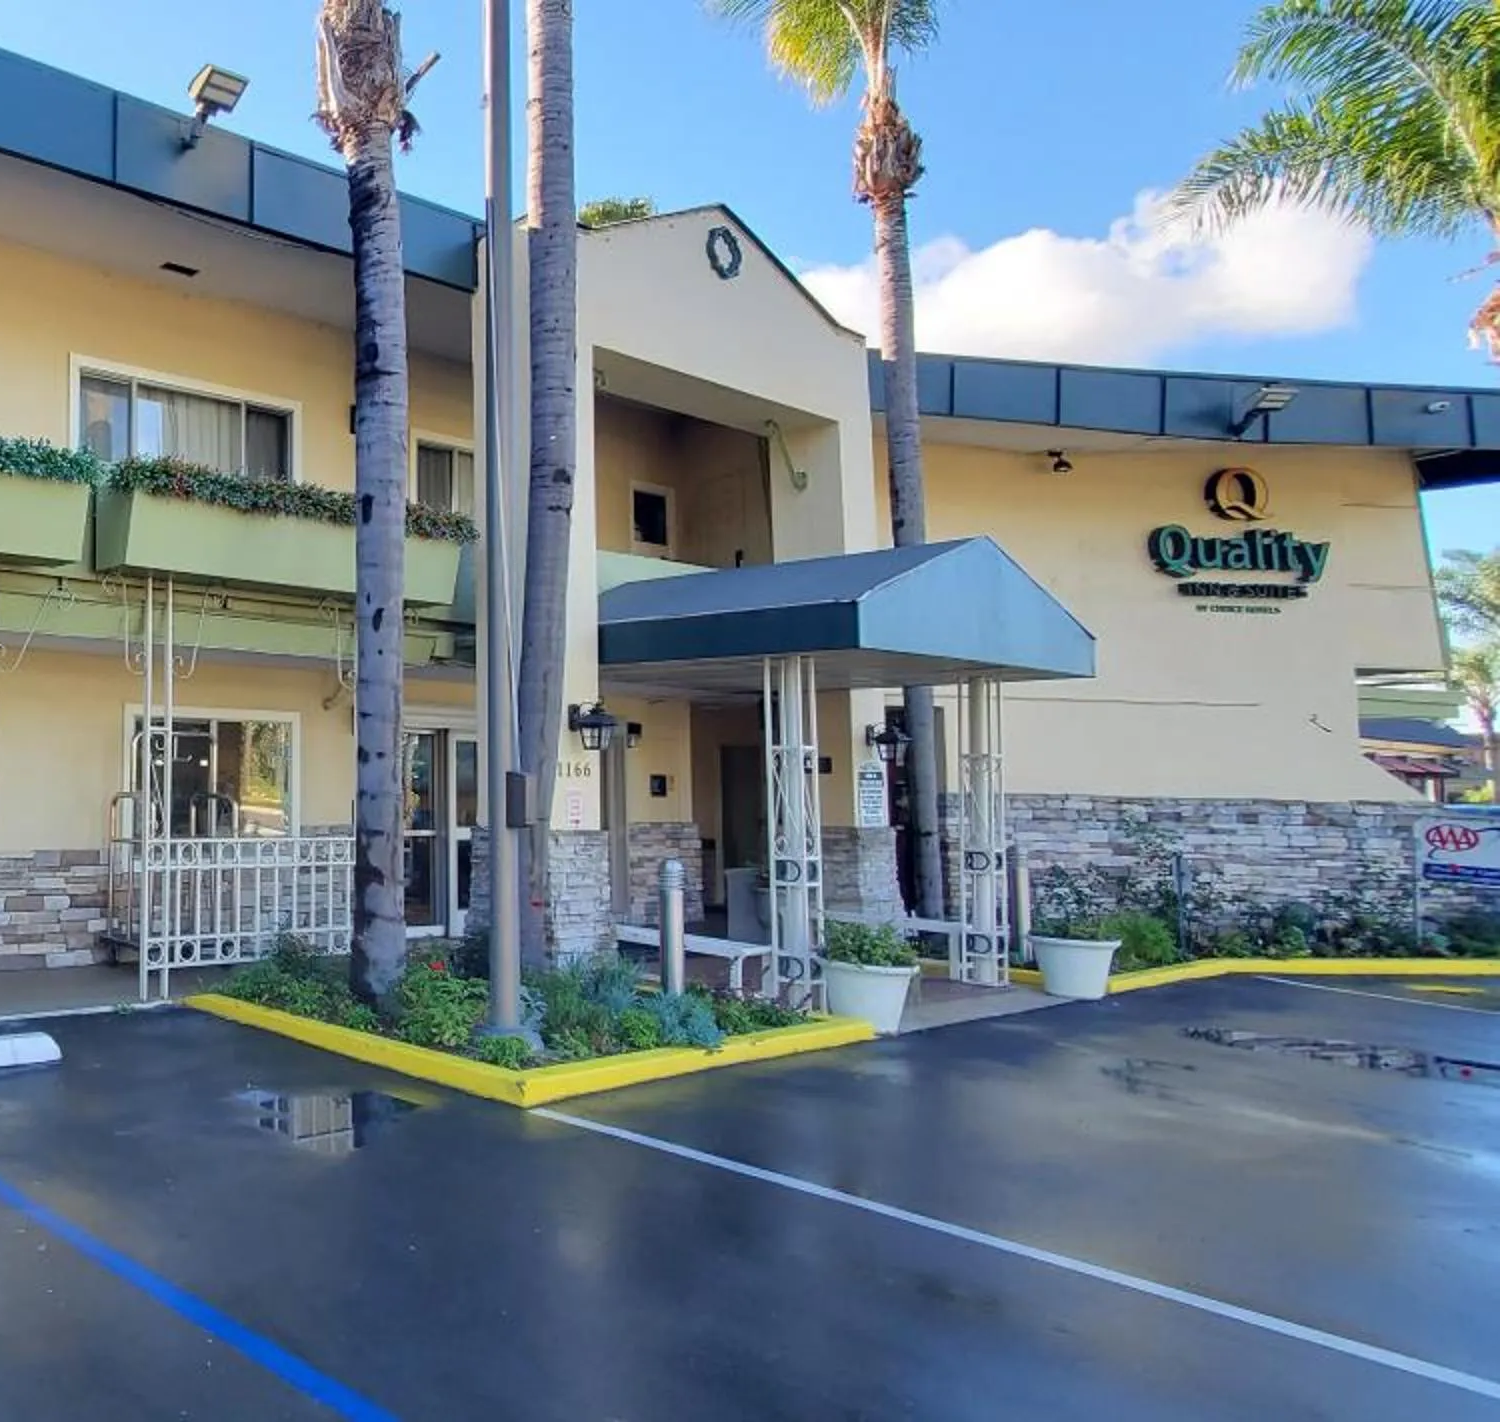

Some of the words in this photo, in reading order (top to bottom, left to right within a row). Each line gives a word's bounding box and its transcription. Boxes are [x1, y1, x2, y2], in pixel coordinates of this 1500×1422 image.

[1148, 523, 1331, 584] Quality
[1177, 582, 1223, 597] INN
[1210, 604, 1242, 614] CHOICE
[558, 762, 591, 777] 1166
[1430, 826, 1475, 851] AAA
